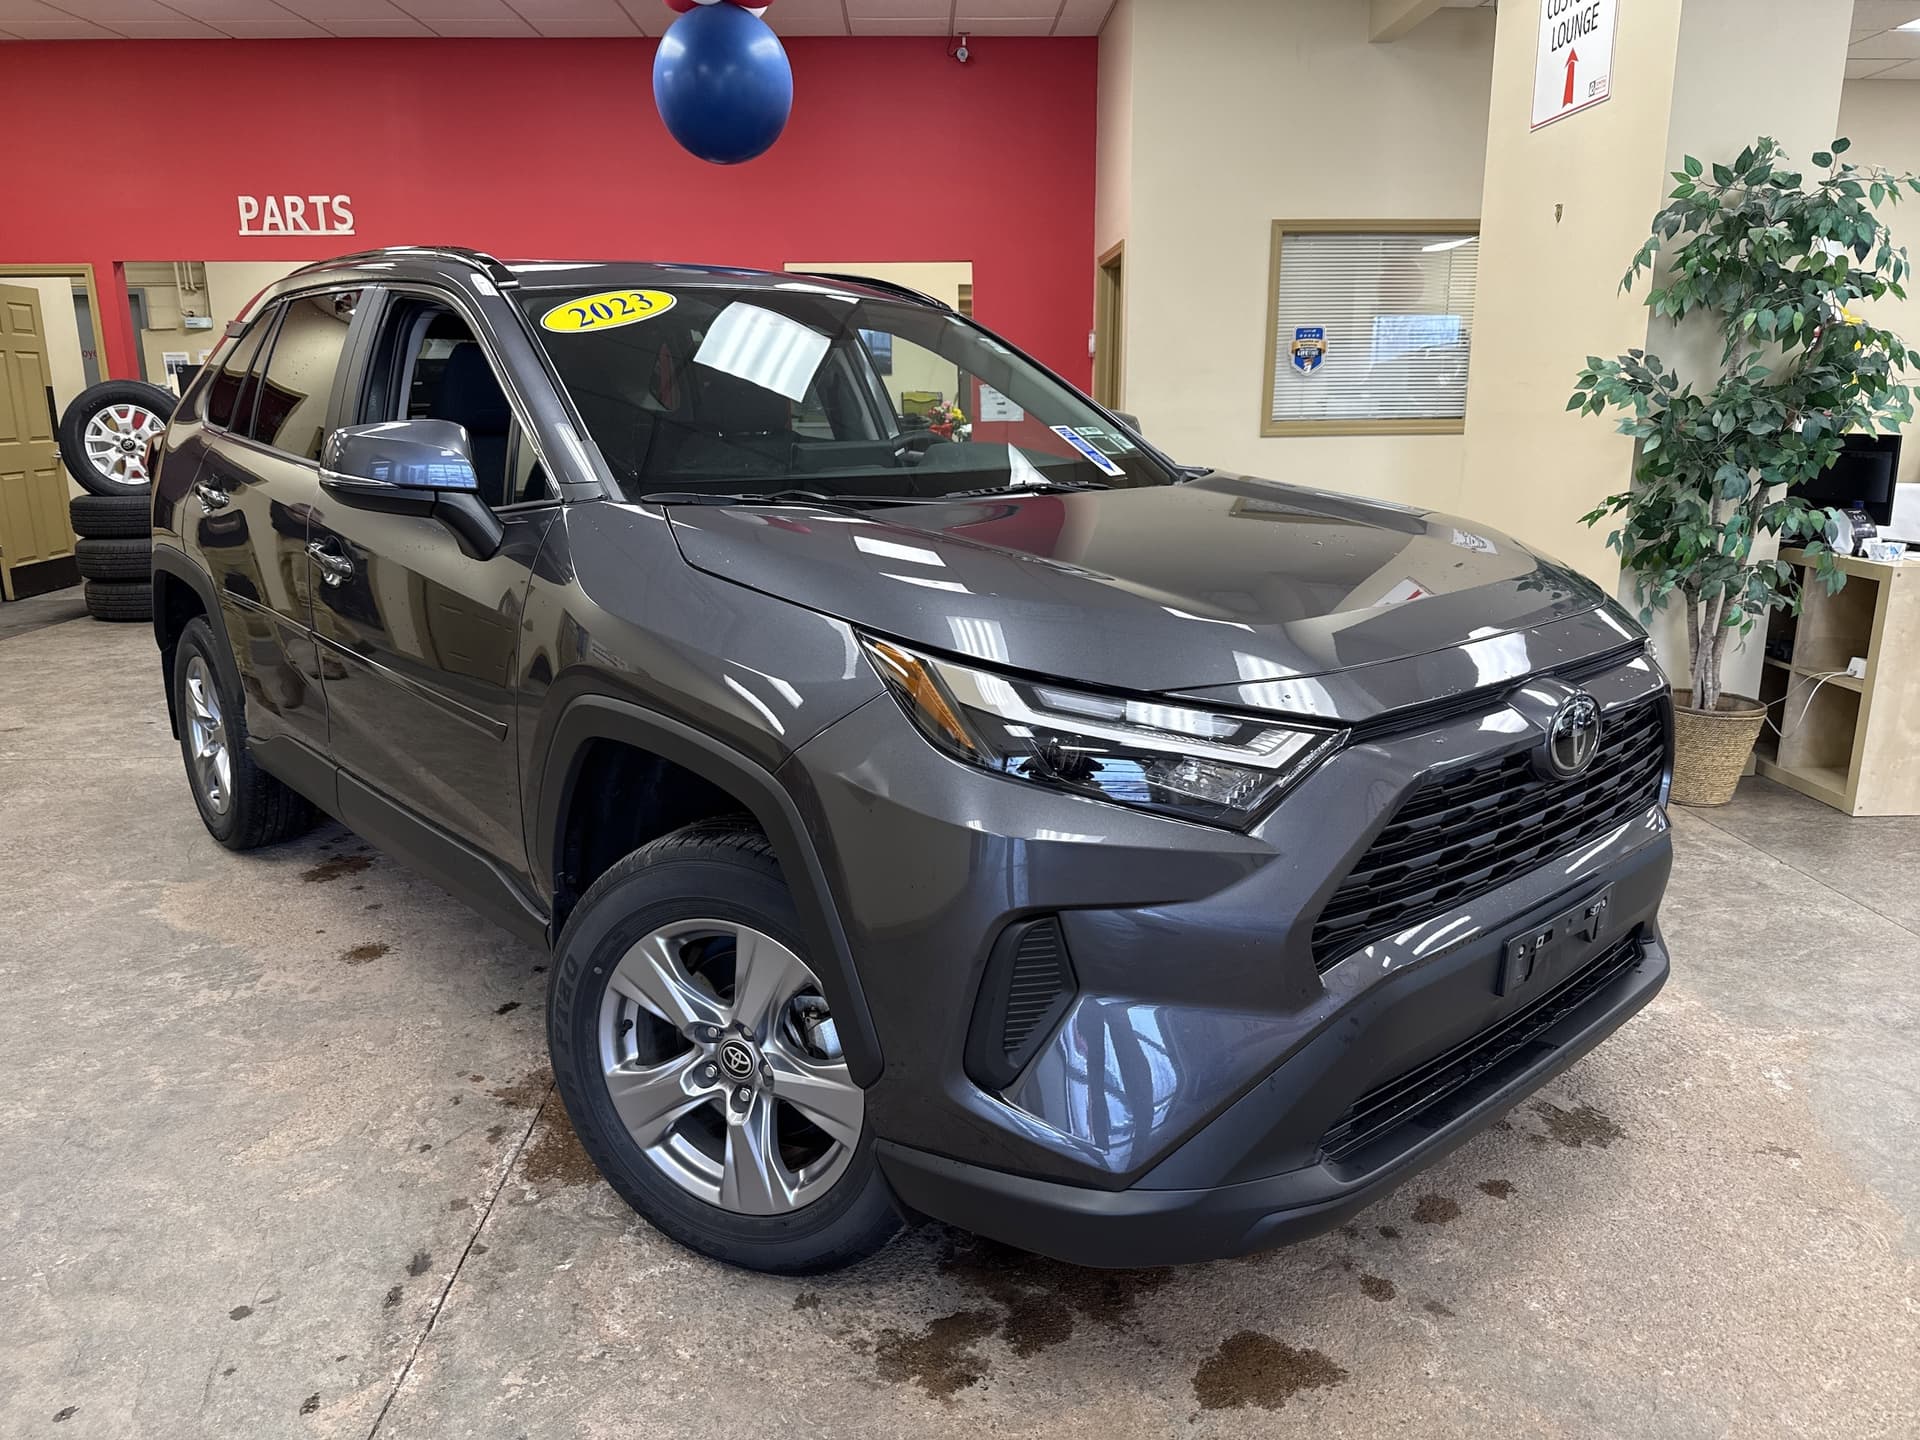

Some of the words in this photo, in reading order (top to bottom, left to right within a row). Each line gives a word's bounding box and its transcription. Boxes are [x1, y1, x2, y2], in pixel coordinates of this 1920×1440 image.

[1551, 2, 1600, 52] LOUNGE
[237, 195, 354, 234] PARTS
[568, 293, 653, 327] 2023
